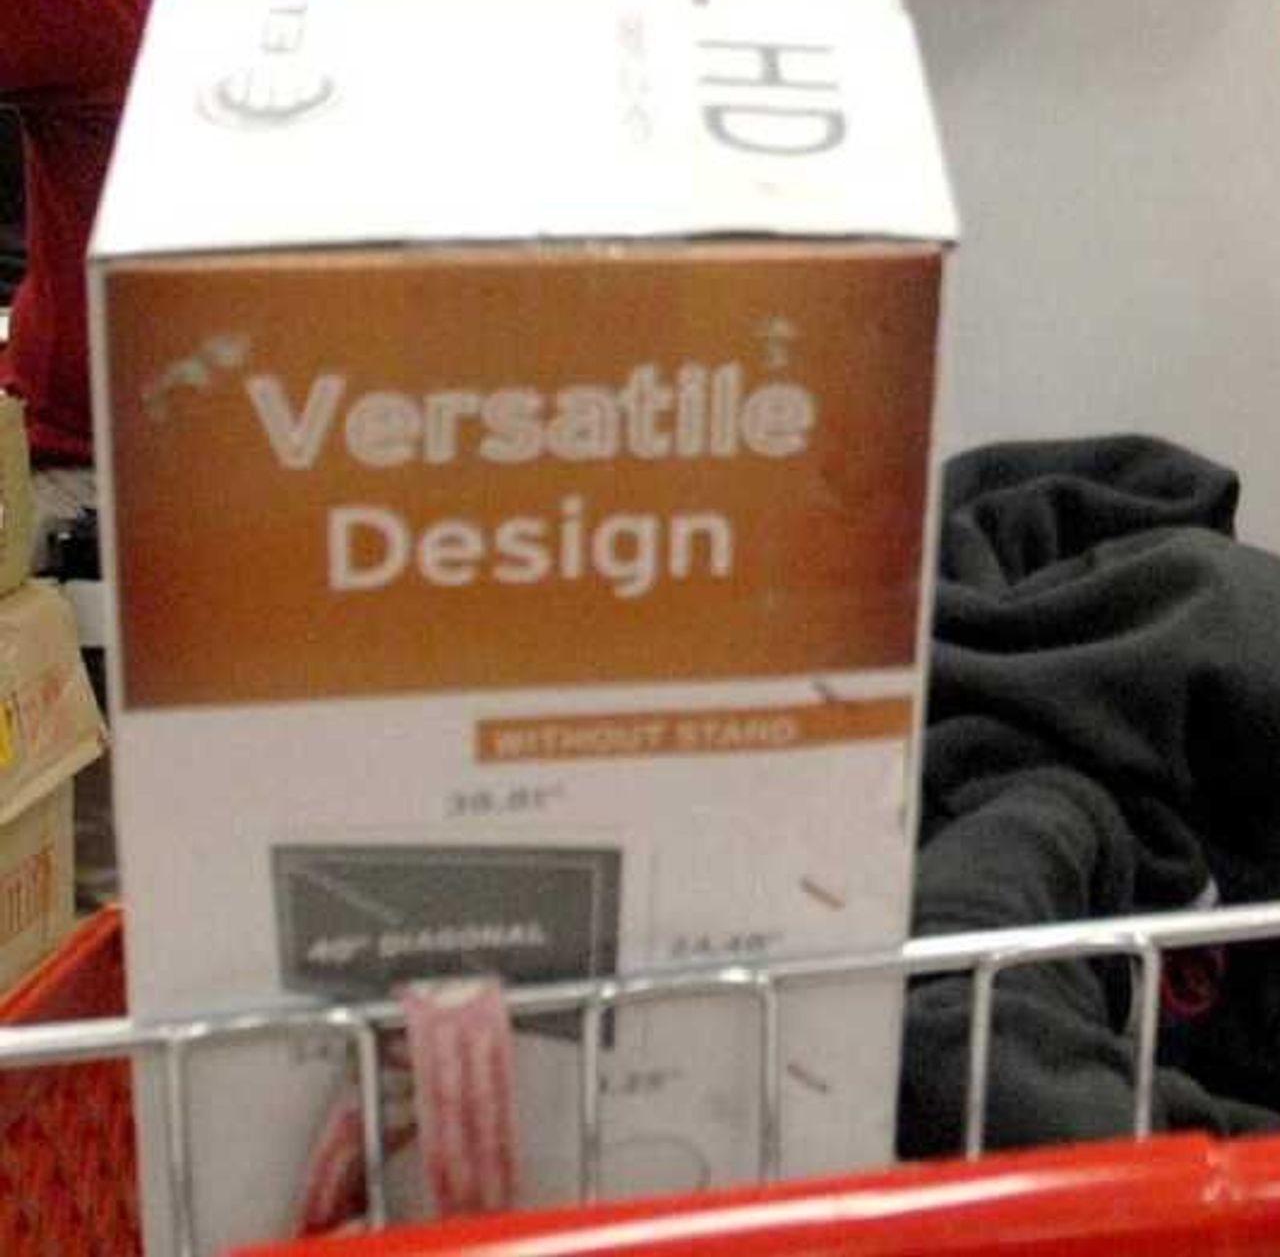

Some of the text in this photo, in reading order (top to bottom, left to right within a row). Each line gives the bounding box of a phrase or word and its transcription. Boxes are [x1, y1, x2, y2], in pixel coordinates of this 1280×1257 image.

[695, 38, 849, 158] HD
[246, 358, 820, 471] Versatile
[326, 494, 734, 600] Design
[497, 712, 798, 755] WITHOUT STAND
